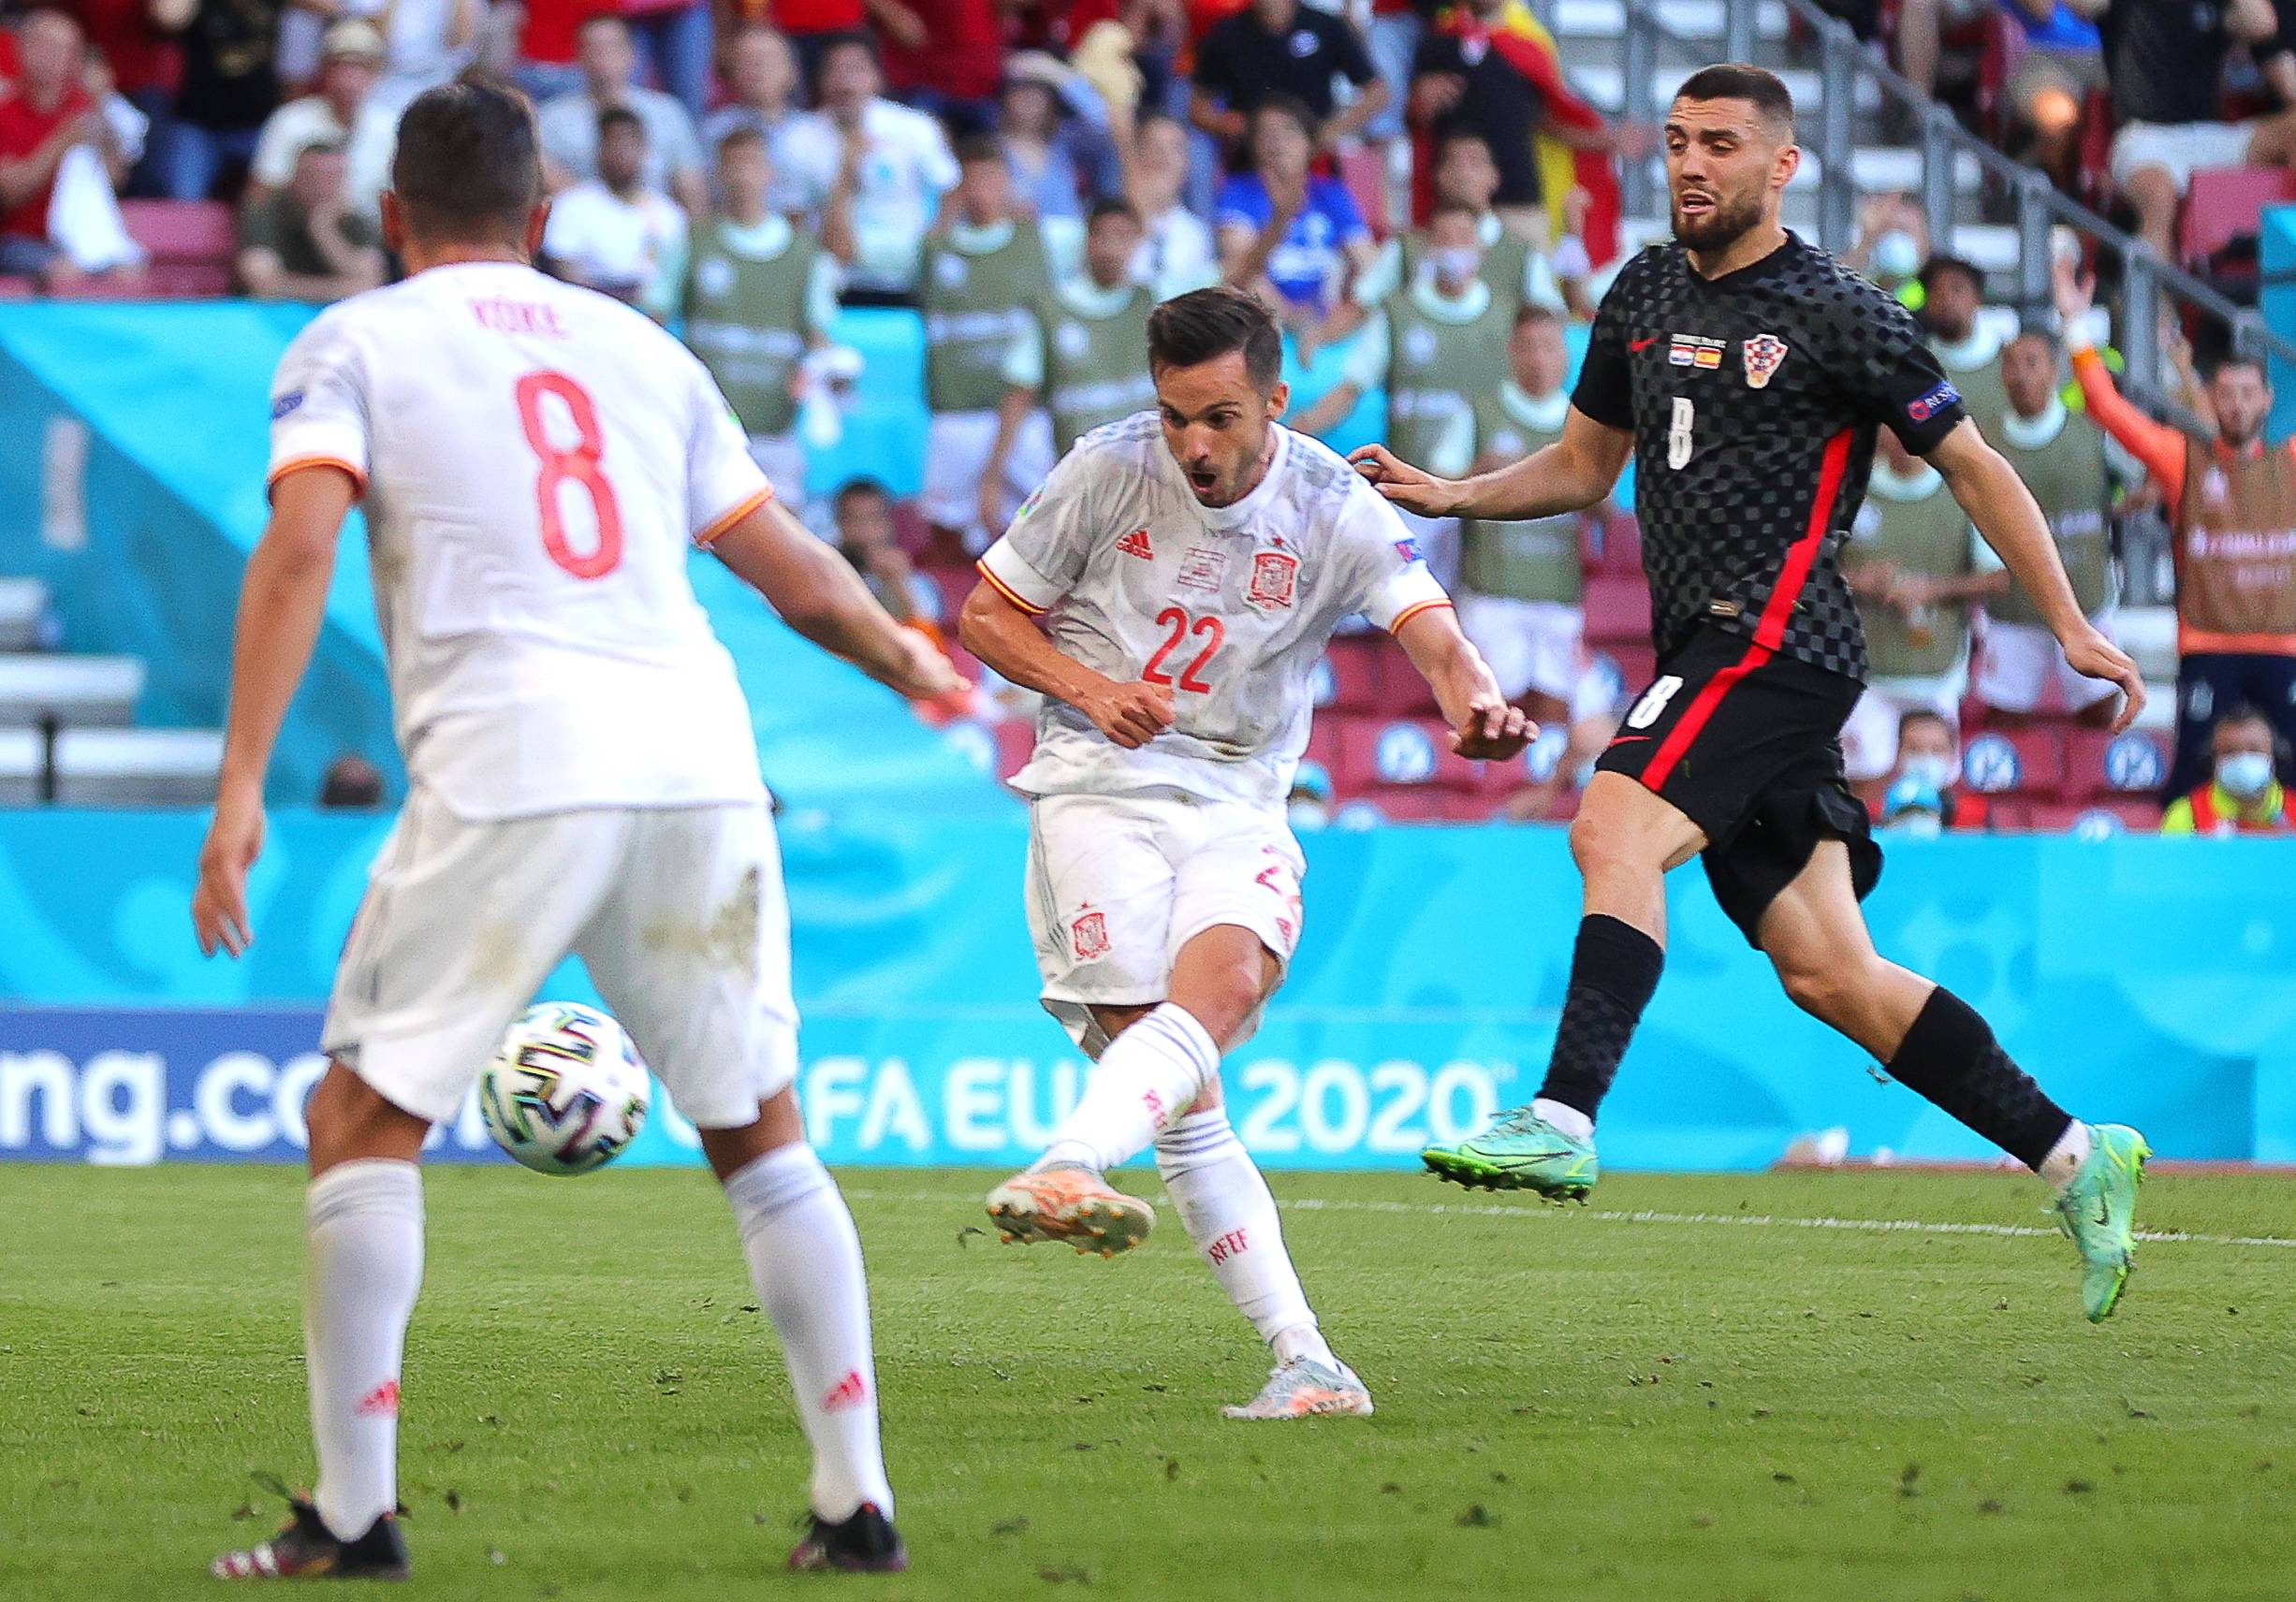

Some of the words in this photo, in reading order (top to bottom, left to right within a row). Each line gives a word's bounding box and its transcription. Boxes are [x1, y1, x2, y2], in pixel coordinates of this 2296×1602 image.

[1667, 396, 1695, 471] 8
[516, 369, 622, 582] 8
[1142, 606, 1225, 694] 22
[1627, 675, 1684, 730] 8
[943, 1057, 1099, 1153] EU
[1238, 1057, 1498, 1154] 2020
[1208, 1228, 1249, 1266] RFEF
